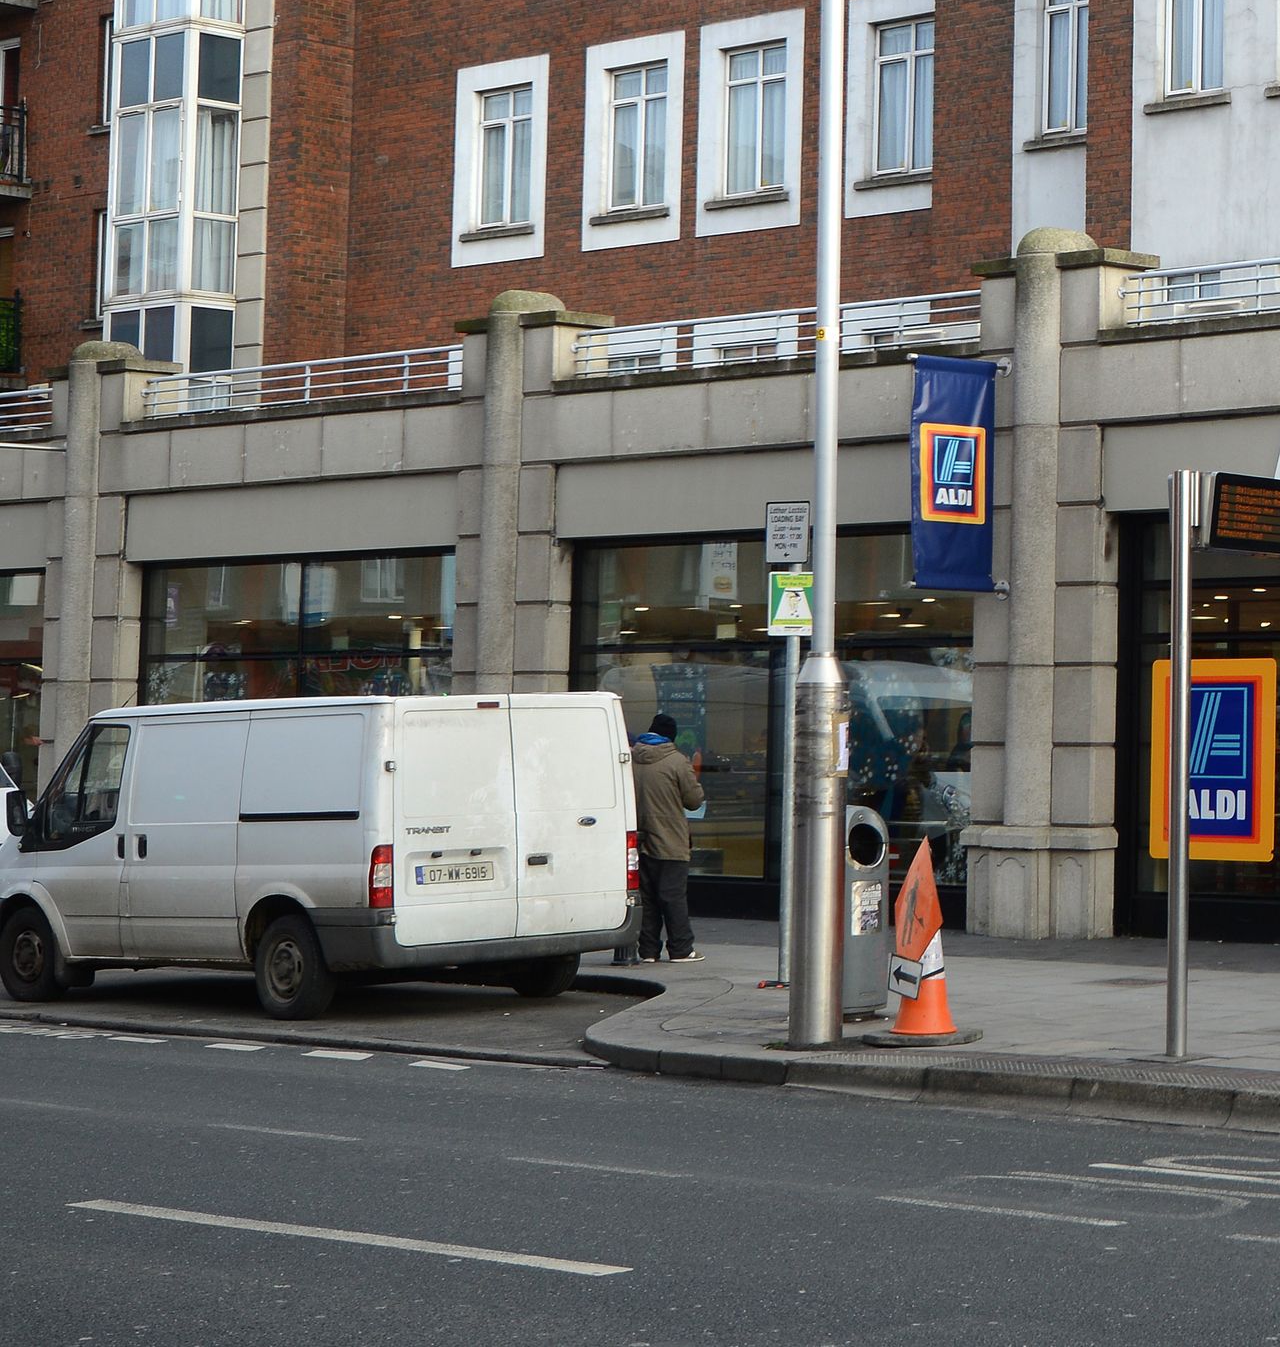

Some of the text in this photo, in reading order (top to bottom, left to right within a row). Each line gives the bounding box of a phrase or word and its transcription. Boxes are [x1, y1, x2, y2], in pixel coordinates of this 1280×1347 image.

[935, 488, 973, 507] ALDI
[405, 826, 451, 835] TRANSIT
[429, 866, 488, 882] 07-WW-6915
